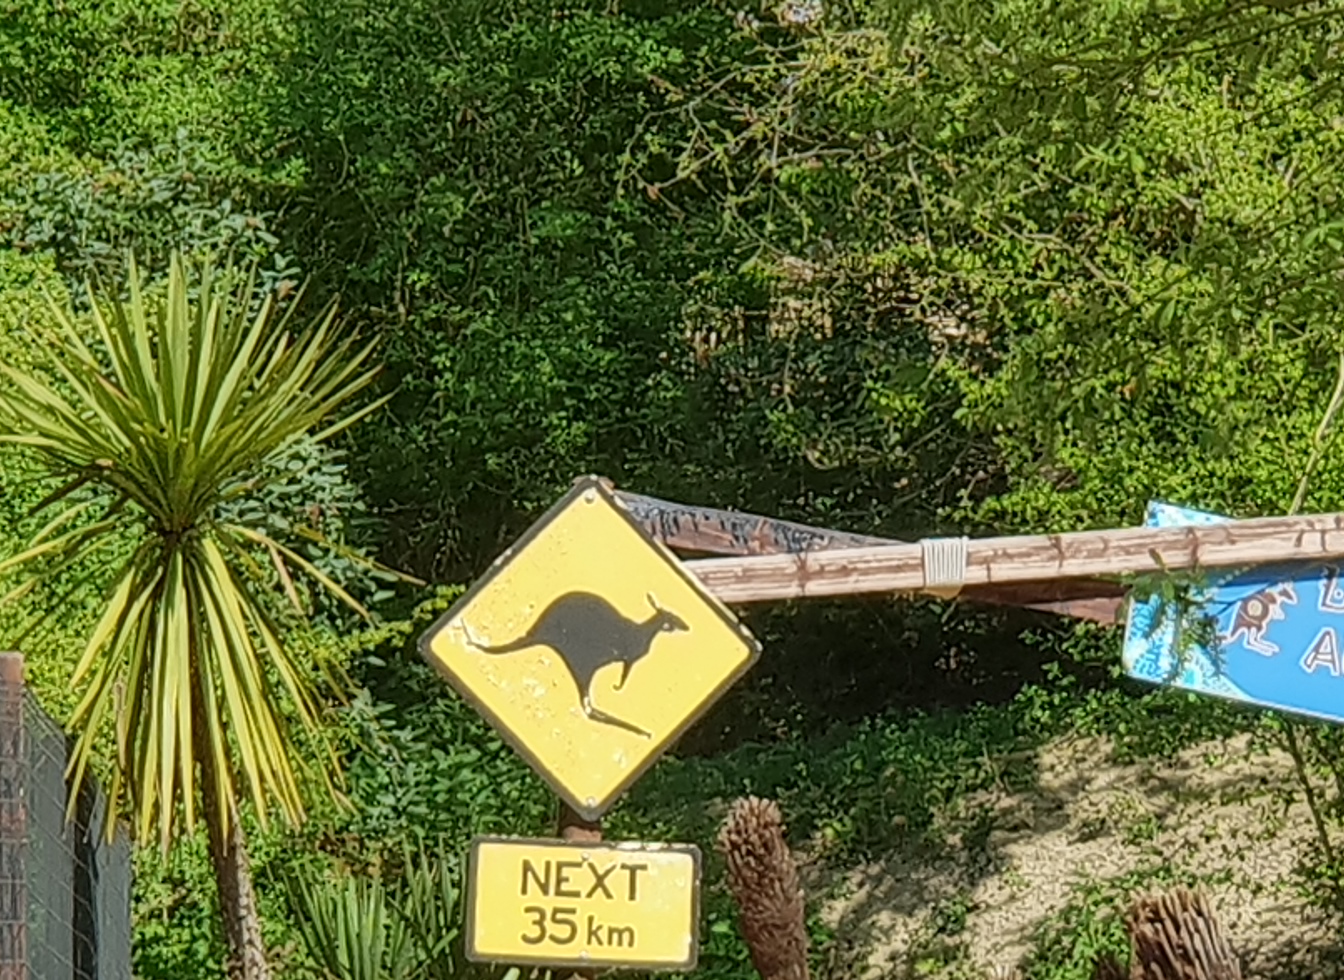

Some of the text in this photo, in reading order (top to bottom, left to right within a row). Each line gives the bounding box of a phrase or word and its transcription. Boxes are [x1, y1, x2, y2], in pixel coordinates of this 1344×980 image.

[520, 859, 648, 901] NEXT
[520, 906, 636, 947] 35 km
